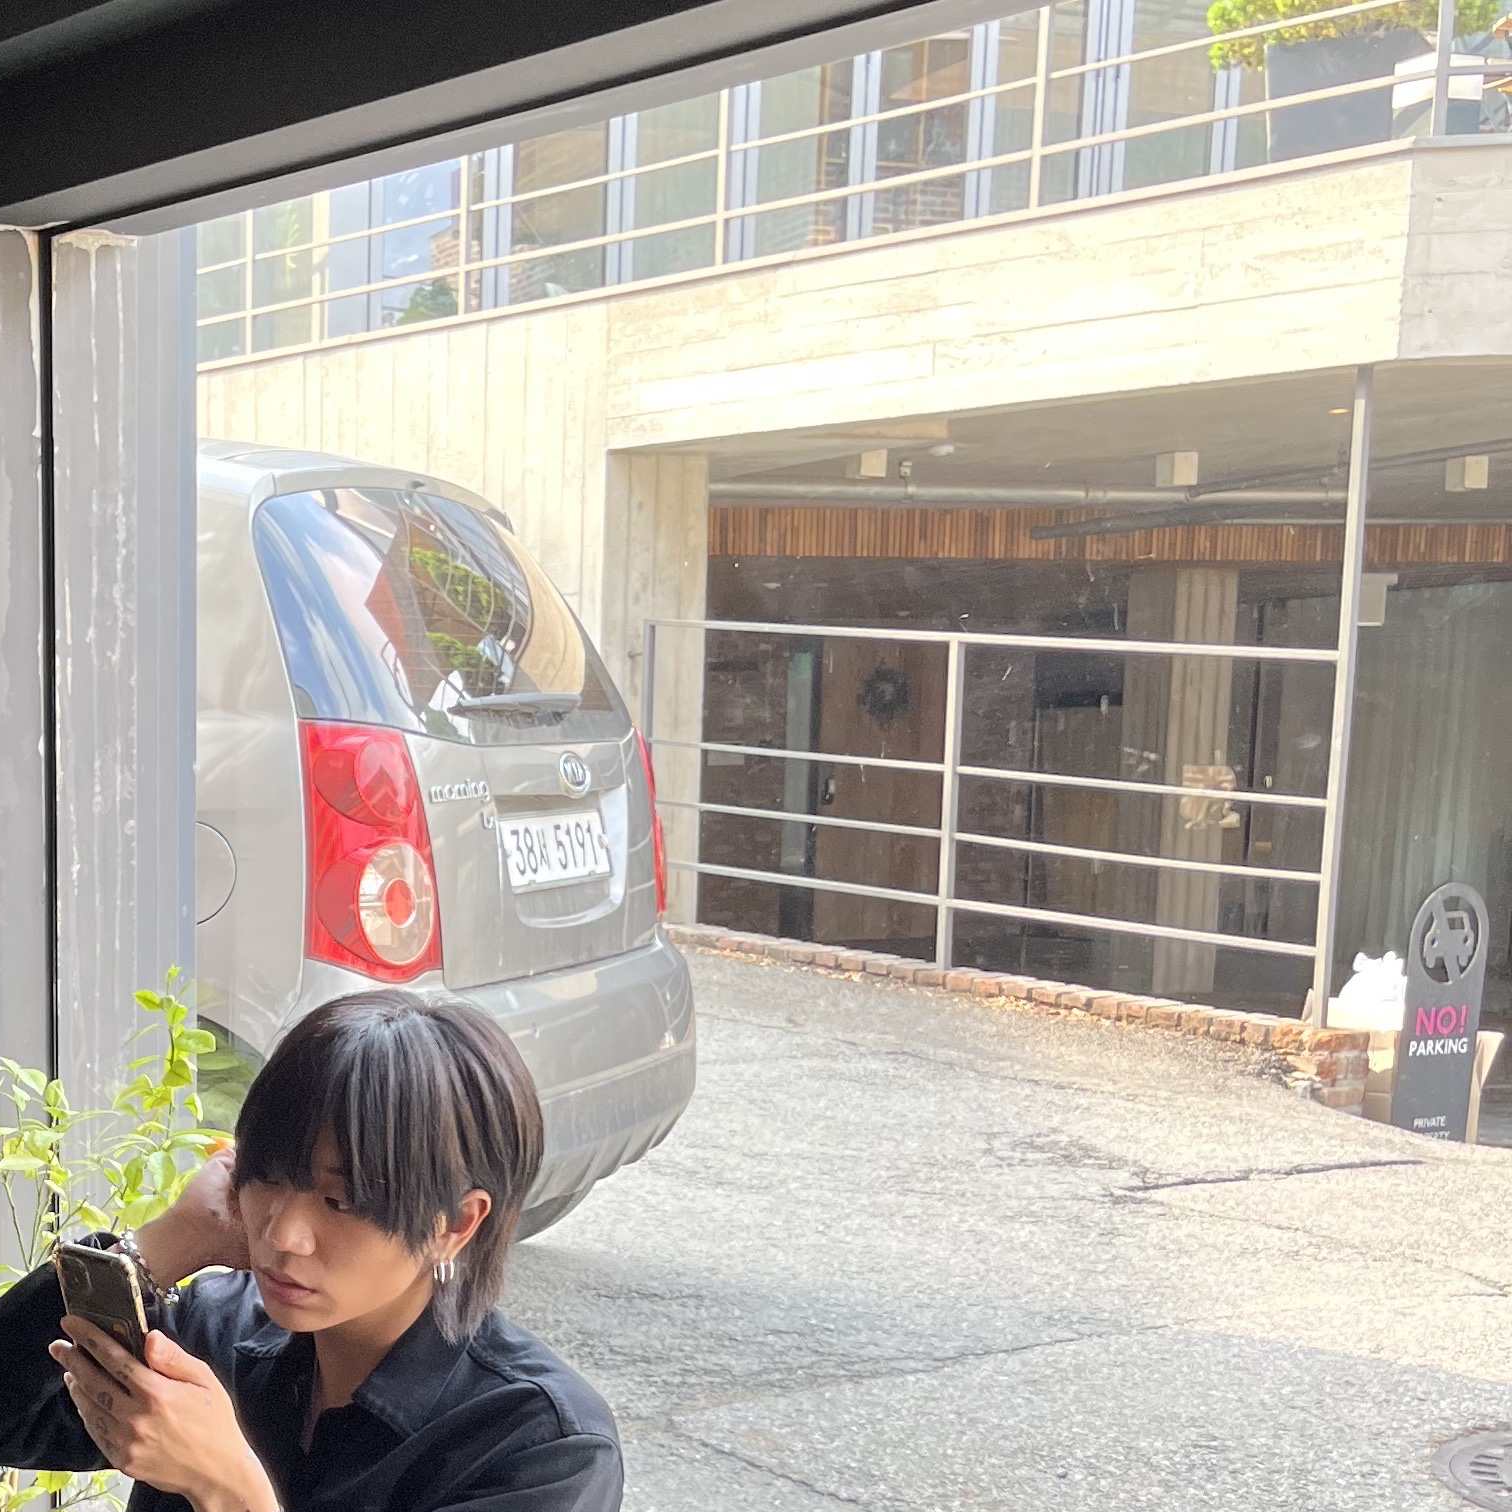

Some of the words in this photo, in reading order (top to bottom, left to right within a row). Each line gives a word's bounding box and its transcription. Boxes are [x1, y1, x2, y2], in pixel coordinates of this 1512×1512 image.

[429, 777, 491, 803] morning
[553, 820, 598, 870] 5191
[1415, 1004, 1468, 1037] NO!
[1408, 1037, 1468, 1057] PARKING
[1413, 1115, 1447, 1129] PRIVATE
